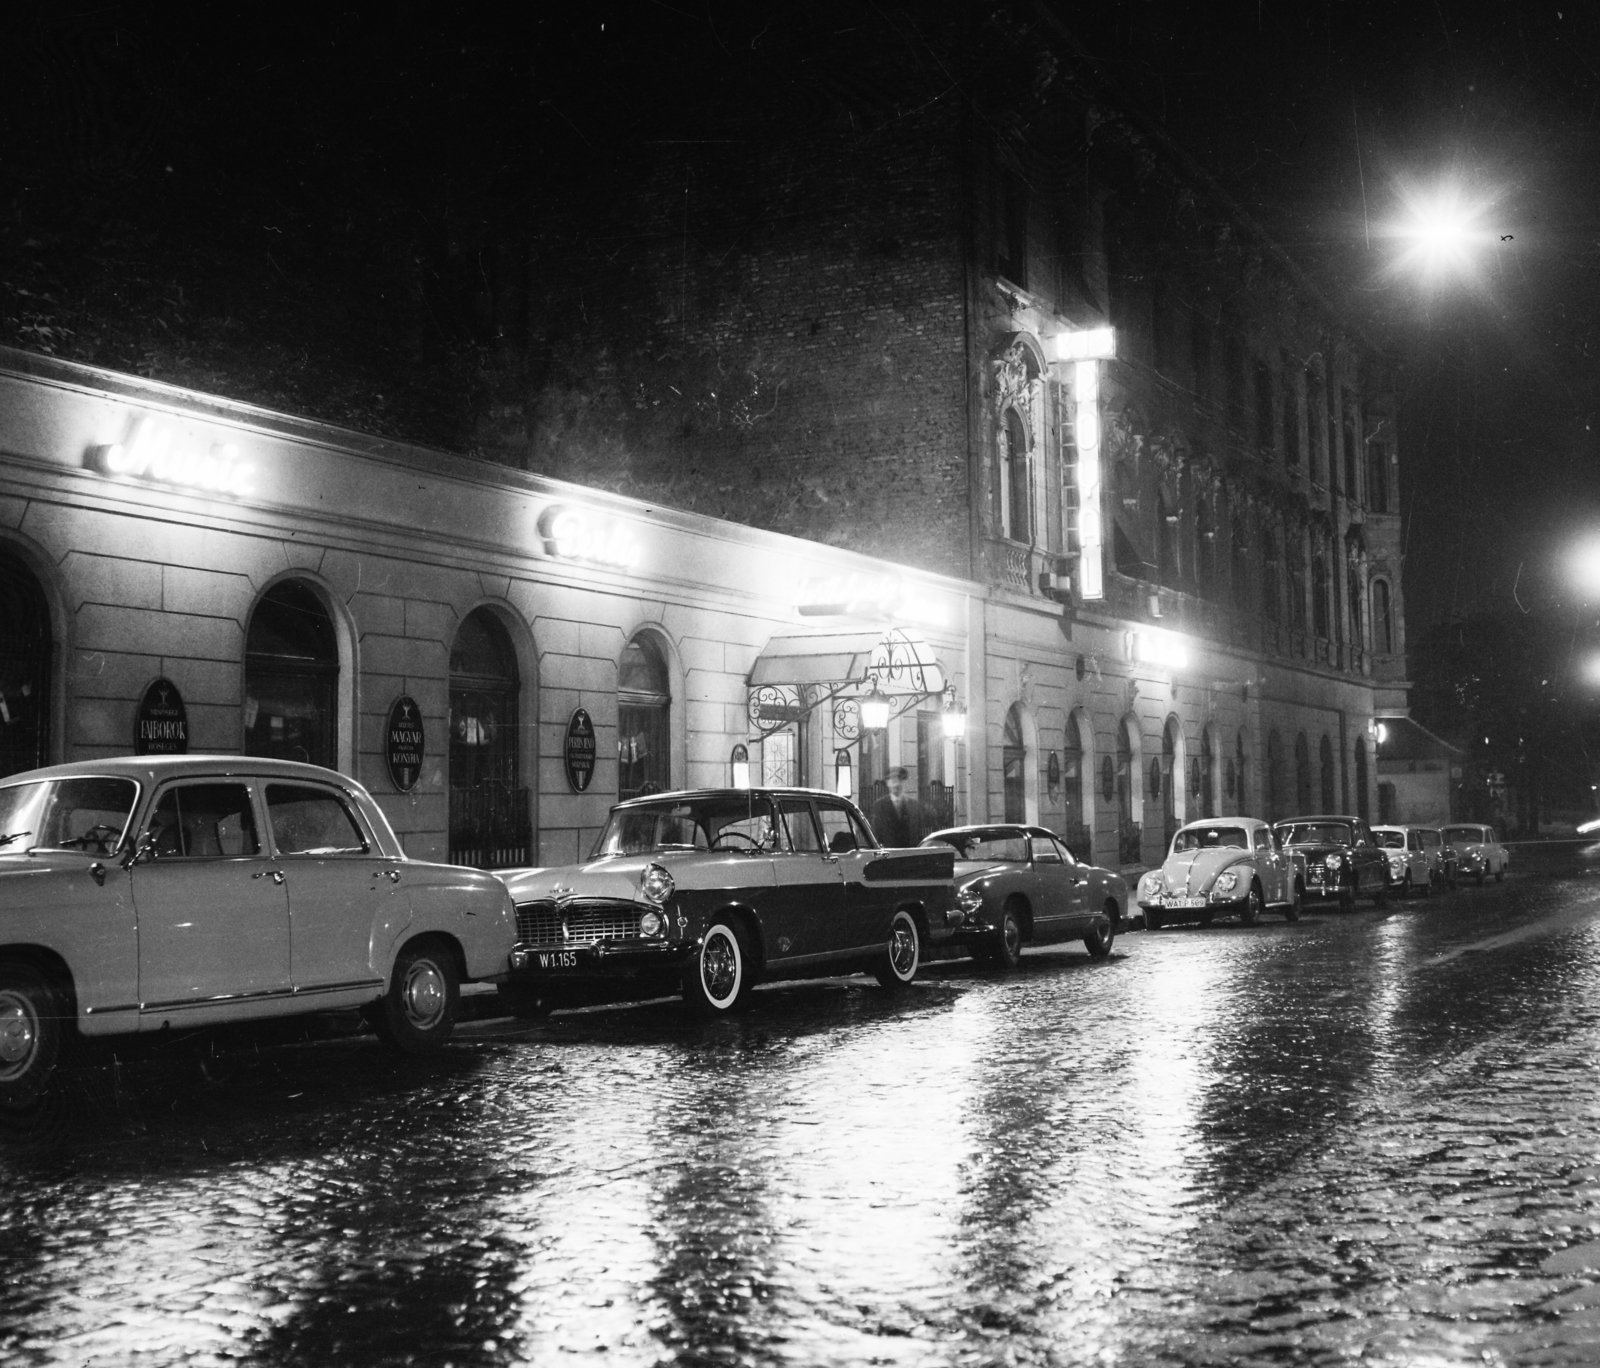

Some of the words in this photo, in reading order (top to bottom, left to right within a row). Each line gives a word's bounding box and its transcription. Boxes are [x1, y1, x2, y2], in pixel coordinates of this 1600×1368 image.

[108, 418, 255, 494] Music
[1075, 364, 1103, 597] ROYAL
[141, 720, 186, 741] FAJBOROK
[390, 730, 422, 744] MAGYAR
[393, 752, 420, 764] KONYHA
